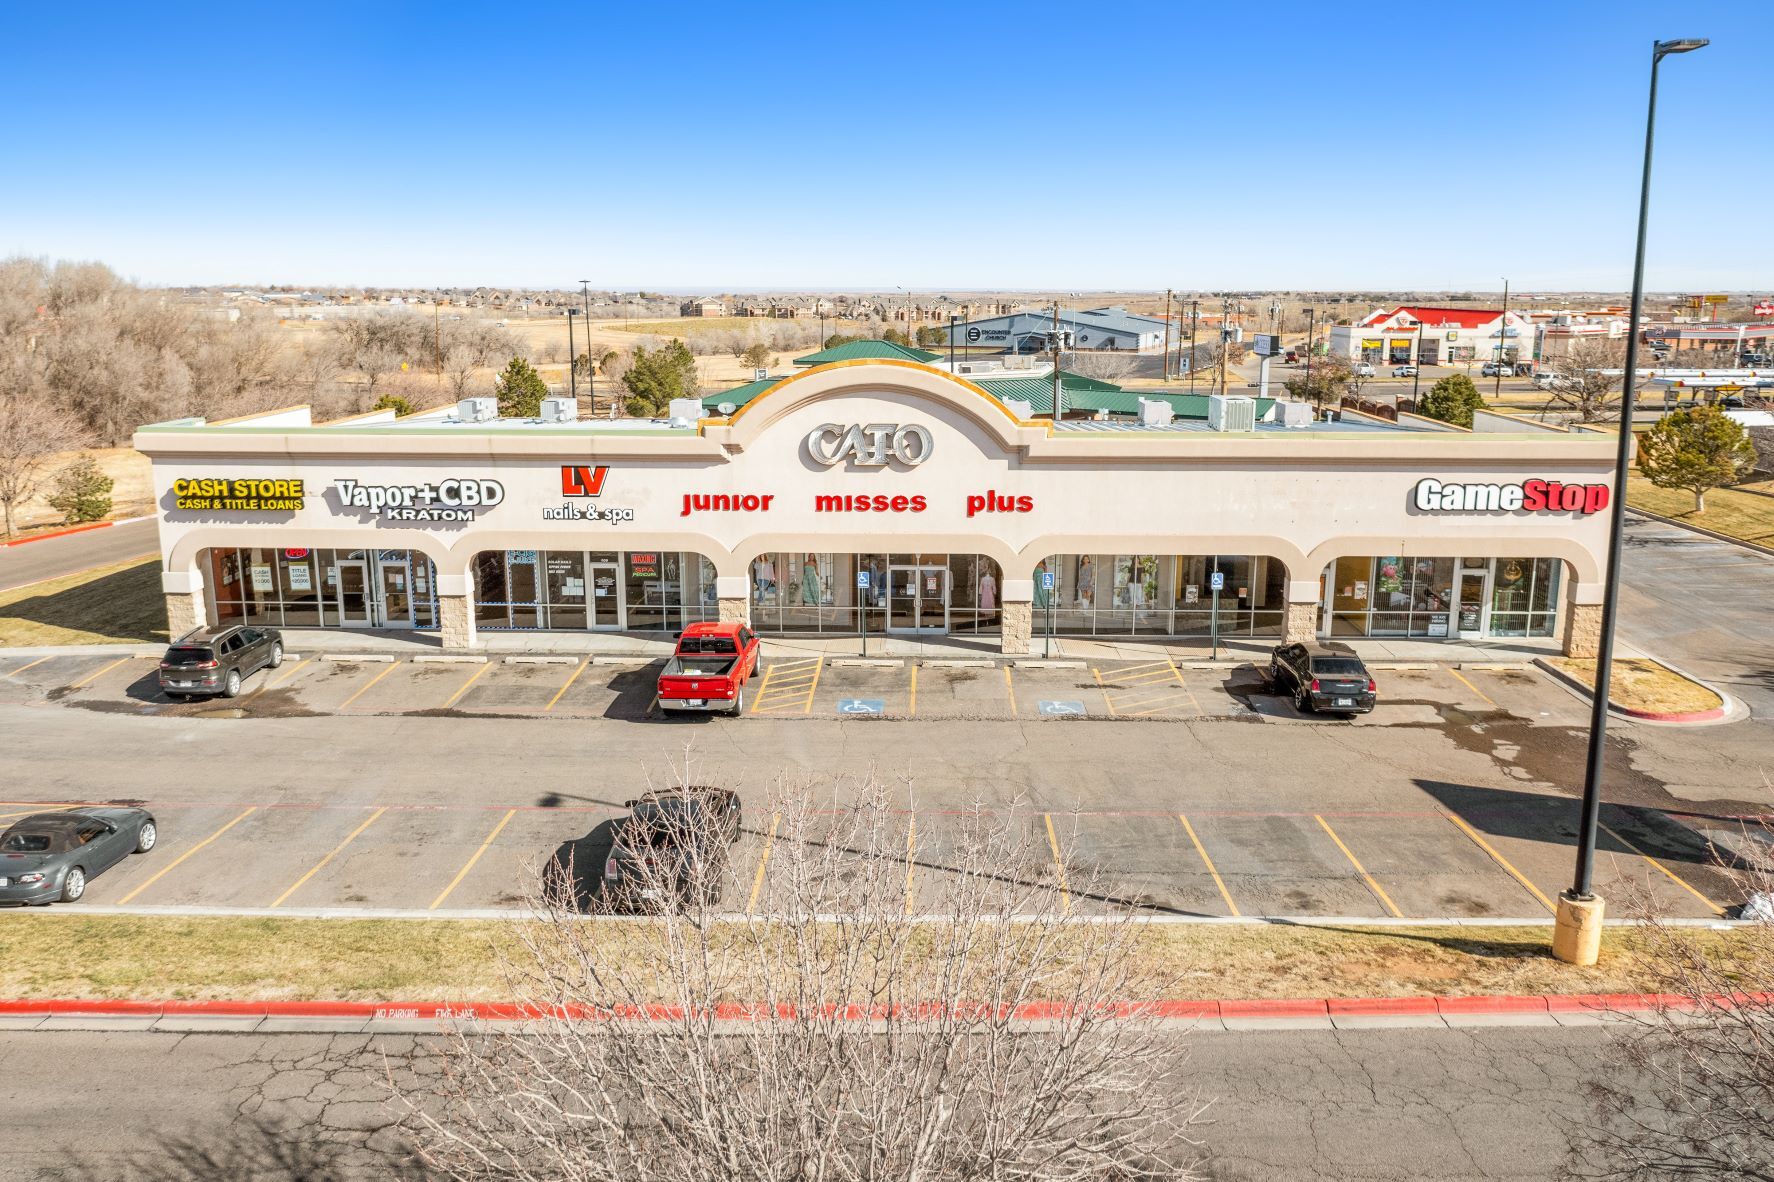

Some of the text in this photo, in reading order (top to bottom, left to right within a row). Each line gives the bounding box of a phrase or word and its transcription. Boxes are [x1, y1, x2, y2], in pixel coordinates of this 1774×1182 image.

[808, 423, 934, 465] CATO
[173, 478, 304, 497] CASH STORE
[561, 465, 610, 497] LV
[176, 499, 304, 510] CASH & TITLE LOANS
[680, 494, 774, 517] junior
[815, 494, 927, 512] misses
[967, 490, 1033, 518] plus
[1415, 478, 1609, 514] GameStop
[387, 507, 475, 521] KRATOM
[543, 502, 634, 525] nails & spa
[375, 1008, 386, 1018] NO
[388, 1008, 419, 1018] PARKING
